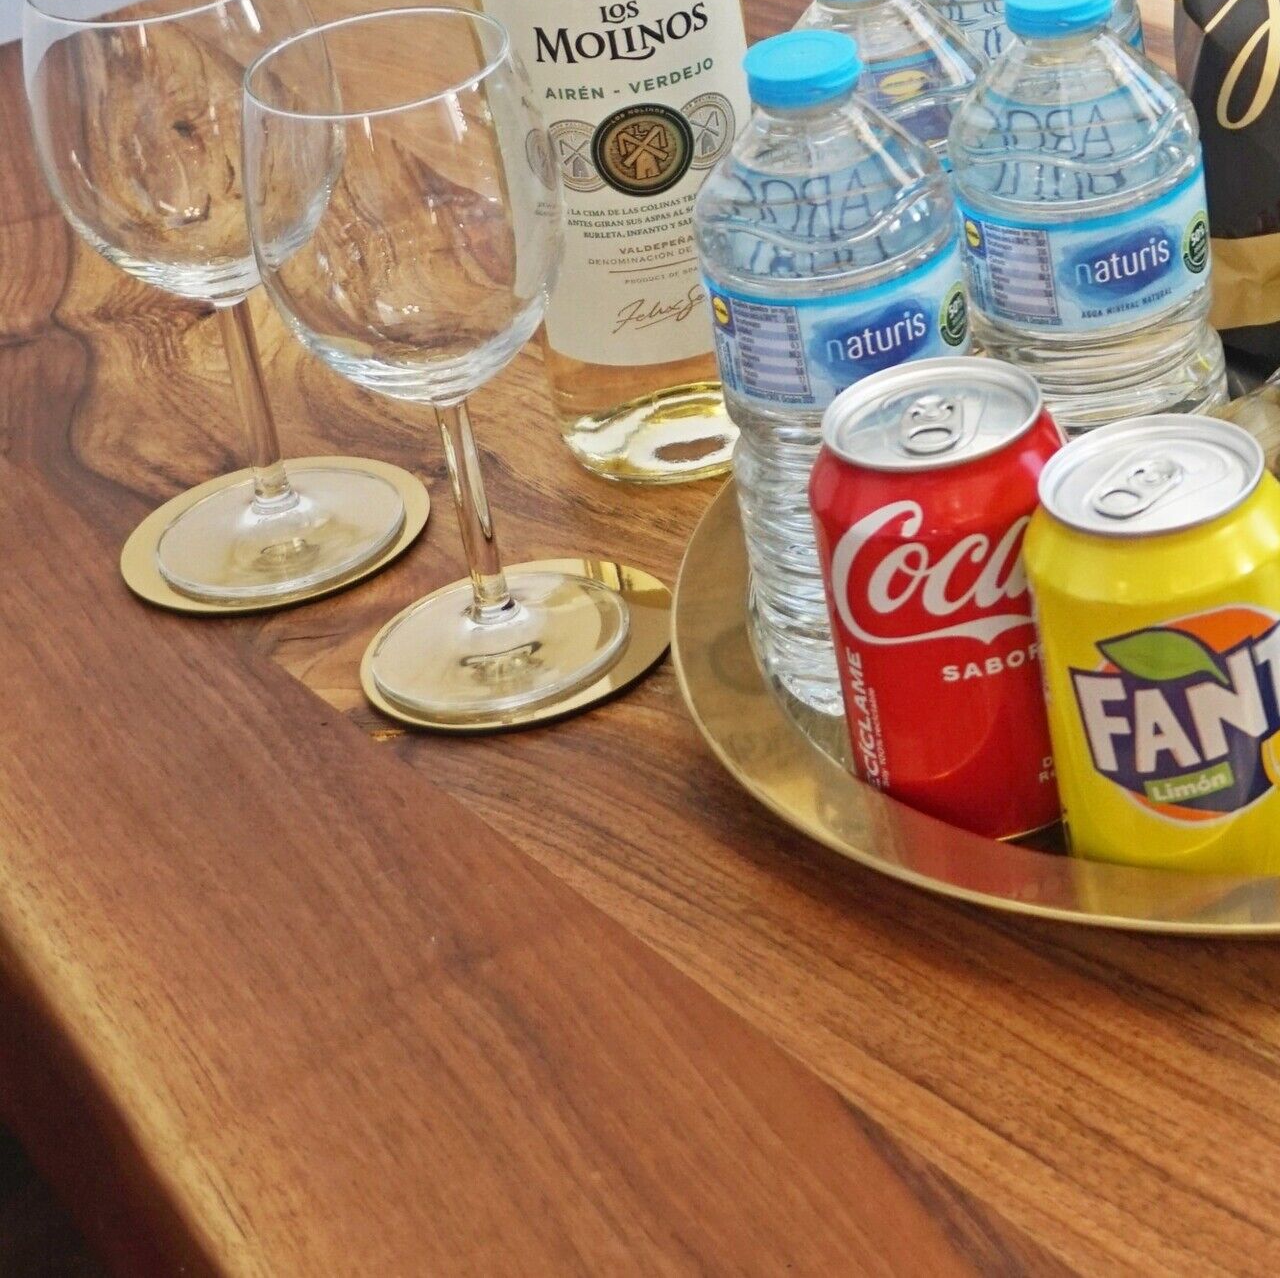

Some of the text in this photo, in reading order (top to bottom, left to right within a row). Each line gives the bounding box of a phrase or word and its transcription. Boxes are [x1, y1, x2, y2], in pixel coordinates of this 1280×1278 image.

[600, 0, 640, 24] LOS
[533, 2, 709, 64] MOLINOS
[545, 85, 605, 101] AIRÉN
[629, 57, 714, 94] VERDEJO
[583, 209, 606, 218] CIMA
[608, 208, 620, 216] DE
[622, 206, 639, 215] LAS
[640, 199, 681, 212] COLINAS
[594, 219, 624, 228] GIRAN
[626, 217, 642, 226] SUS
[644, 211, 672, 224] ASPAS
[673, 208, 684, 218] AL
[627, 224, 668, 238] INFANTO
[588, 245, 693, 266] DENOMINACIÓN DE
[619, 235, 694, 255] VALDEPEÑA
[1075, 238, 1170, 284] naturis
[625, 273, 666, 285] PRODUCT
[826, 311, 926, 362] naturis
[832, 499, 1031, 645] Coca
[1153, 771, 1229, 801] Limón
